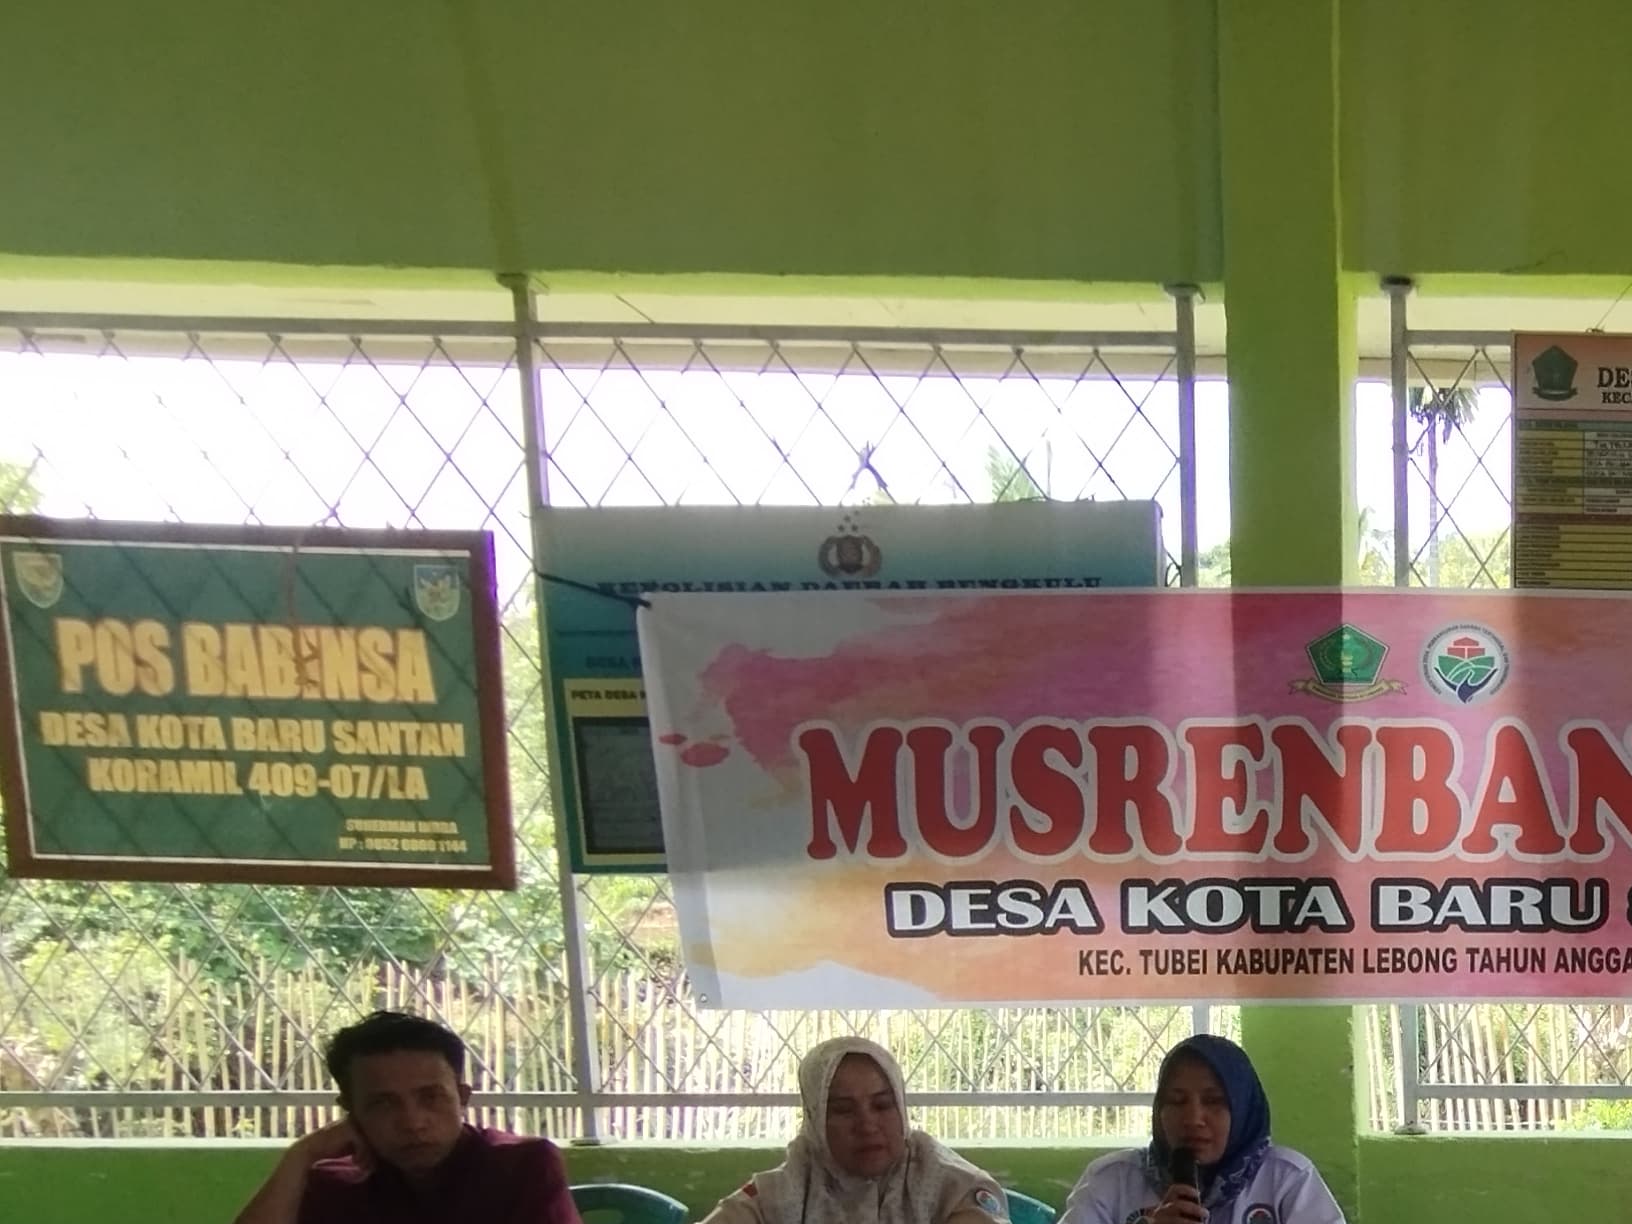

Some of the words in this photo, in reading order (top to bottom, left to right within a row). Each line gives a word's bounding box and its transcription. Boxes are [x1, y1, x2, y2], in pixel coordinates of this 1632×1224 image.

[54, 617, 175, 696] POS
[40, 711, 133, 748] DESA
[136, 714, 227, 750] KOTA
[231, 717, 327, 754] BARU
[332, 720, 465, 757] SANTAN
[87, 757, 243, 795] KORAMIL
[249, 762, 429, 800] 409-07/LA
[887, 879, 1104, 936] DESA
[1121, 879, 1353, 934] KOTA
[1371, 878, 1609, 934] BARU
[1078, 949, 1131, 976] KEC.
[1139, 949, 1208, 975] TUBEI
[1216, 948, 1354, 975] KABUPATEN
[1362, 947, 1457, 974] LEBONG
[1465, 947, 1546, 973] TAHUN
